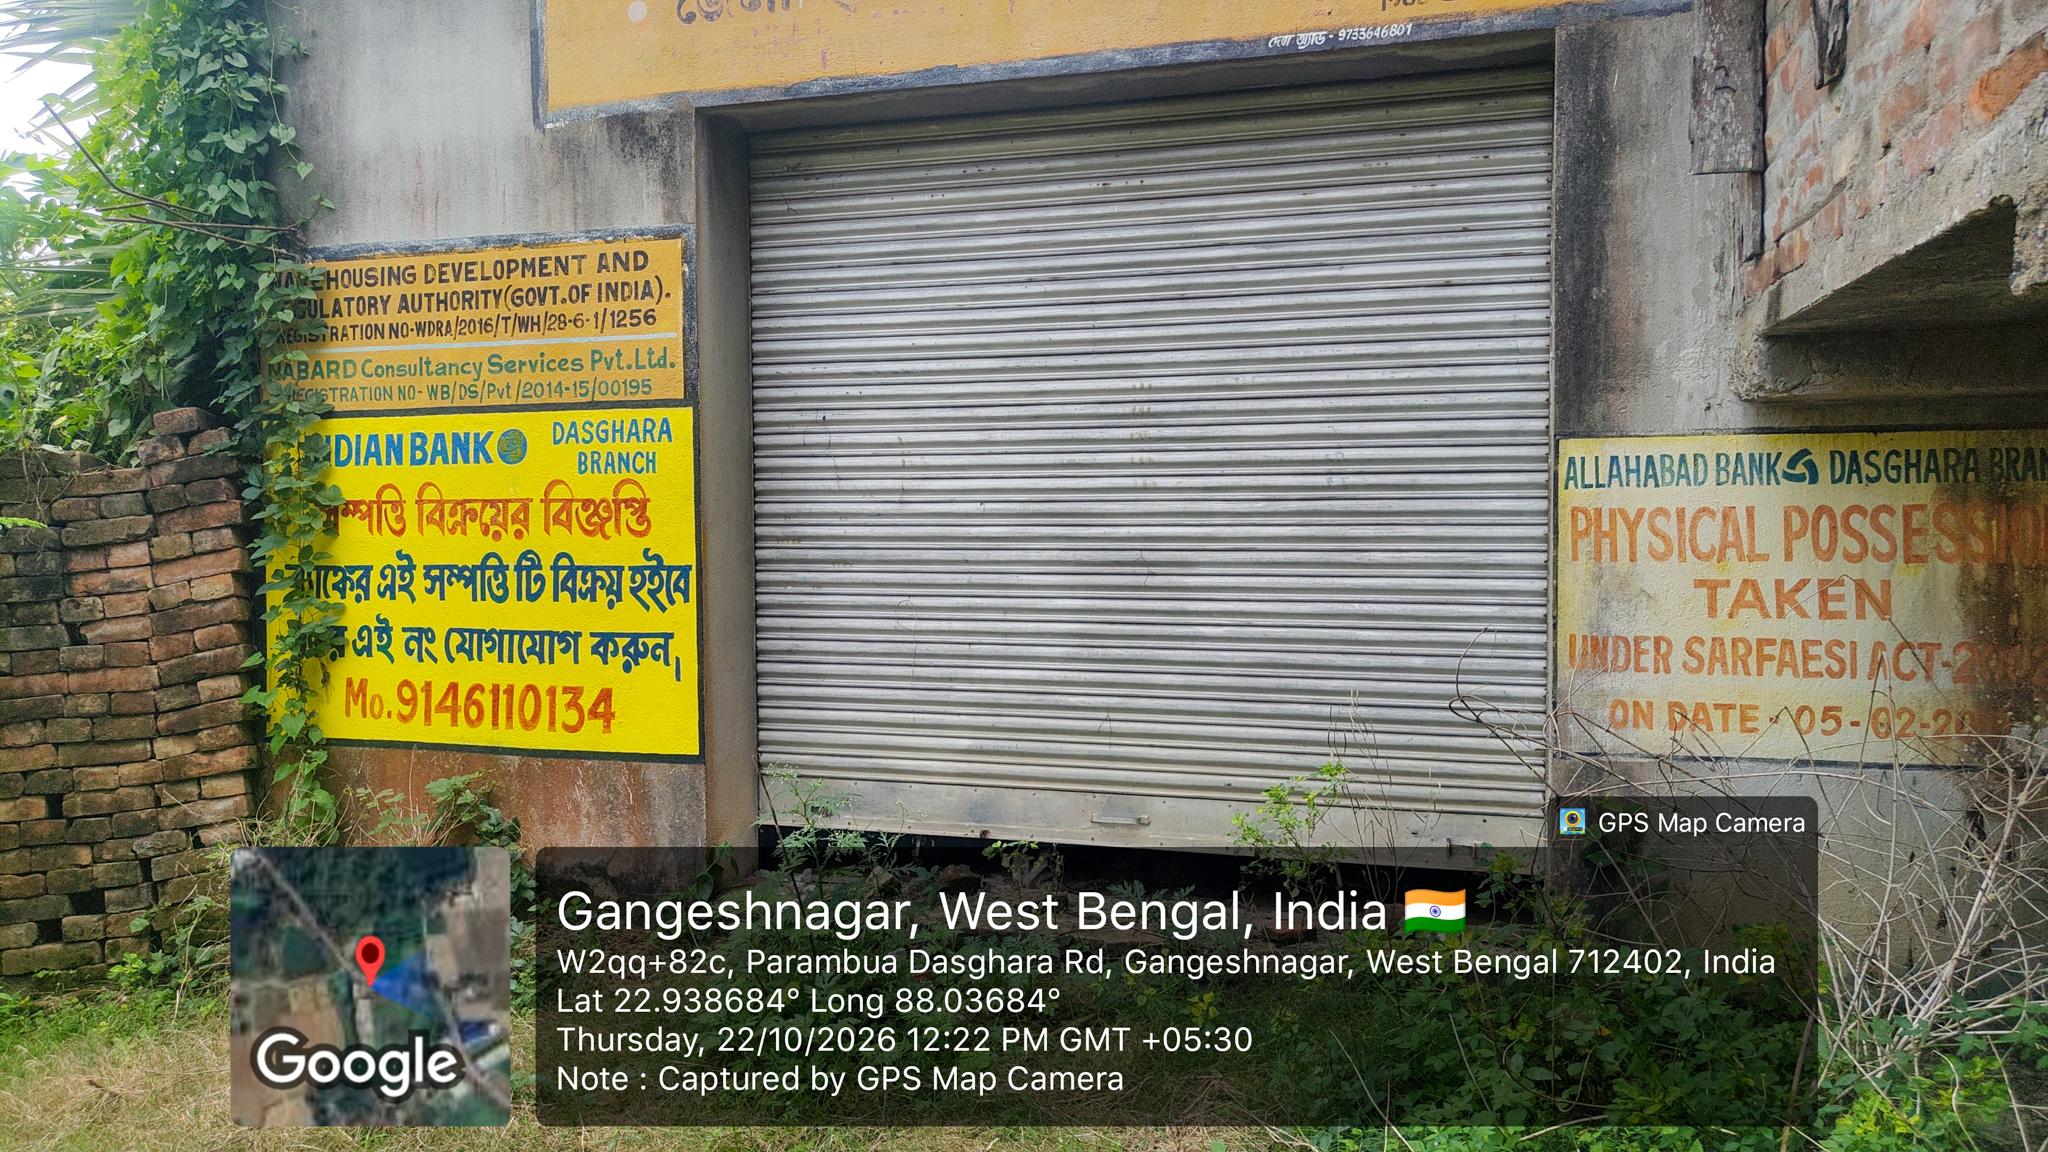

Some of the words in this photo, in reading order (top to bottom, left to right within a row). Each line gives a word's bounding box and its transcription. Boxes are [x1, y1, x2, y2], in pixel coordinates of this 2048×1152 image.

[1338, 22, 1413, 41] 9733646801
[424, 254, 588, 285] DEVELOPMENT
[596, 250, 649, 274] AND
[597, 275, 671, 306] INDIA).
[268, 358, 357, 381] NABARD
[361, 354, 483, 382] Consultancy
[487, 351, 585, 376] Services
[409, 430, 495, 466] BANK
[552, 416, 673, 445] DASGHARA
[577, 450, 657, 475] BRANCH
[1564, 453, 1708, 490] ALLAHABAD
[1715, 451, 1783, 486] BANK
[1829, 447, 1981, 485] DASGHARA
[1570, 505, 1770, 563] PHYSICAL
[1783, 503, 2048, 564] POSSESSIO
[377, 550, 417, 604] এই
[423, 551, 509, 604] সম্পত্তি
[513, 549, 547, 603] টি
[550, 551, 625, 610] বিক্রয়
[627, 547, 693, 614] হইবে
[1693, 578, 1893, 620] TAKEN
[352, 613, 395, 664] এই
[401, 626, 438, 664] নং
[444, 627, 583, 665] যোগাযোগ
[1568, 633, 1673, 675] UNDER
[1682, 636, 1858, 680] SARFAESI
[1608, 699, 1654, 731] ON
[1667, 701, 1760, 734] DATE
